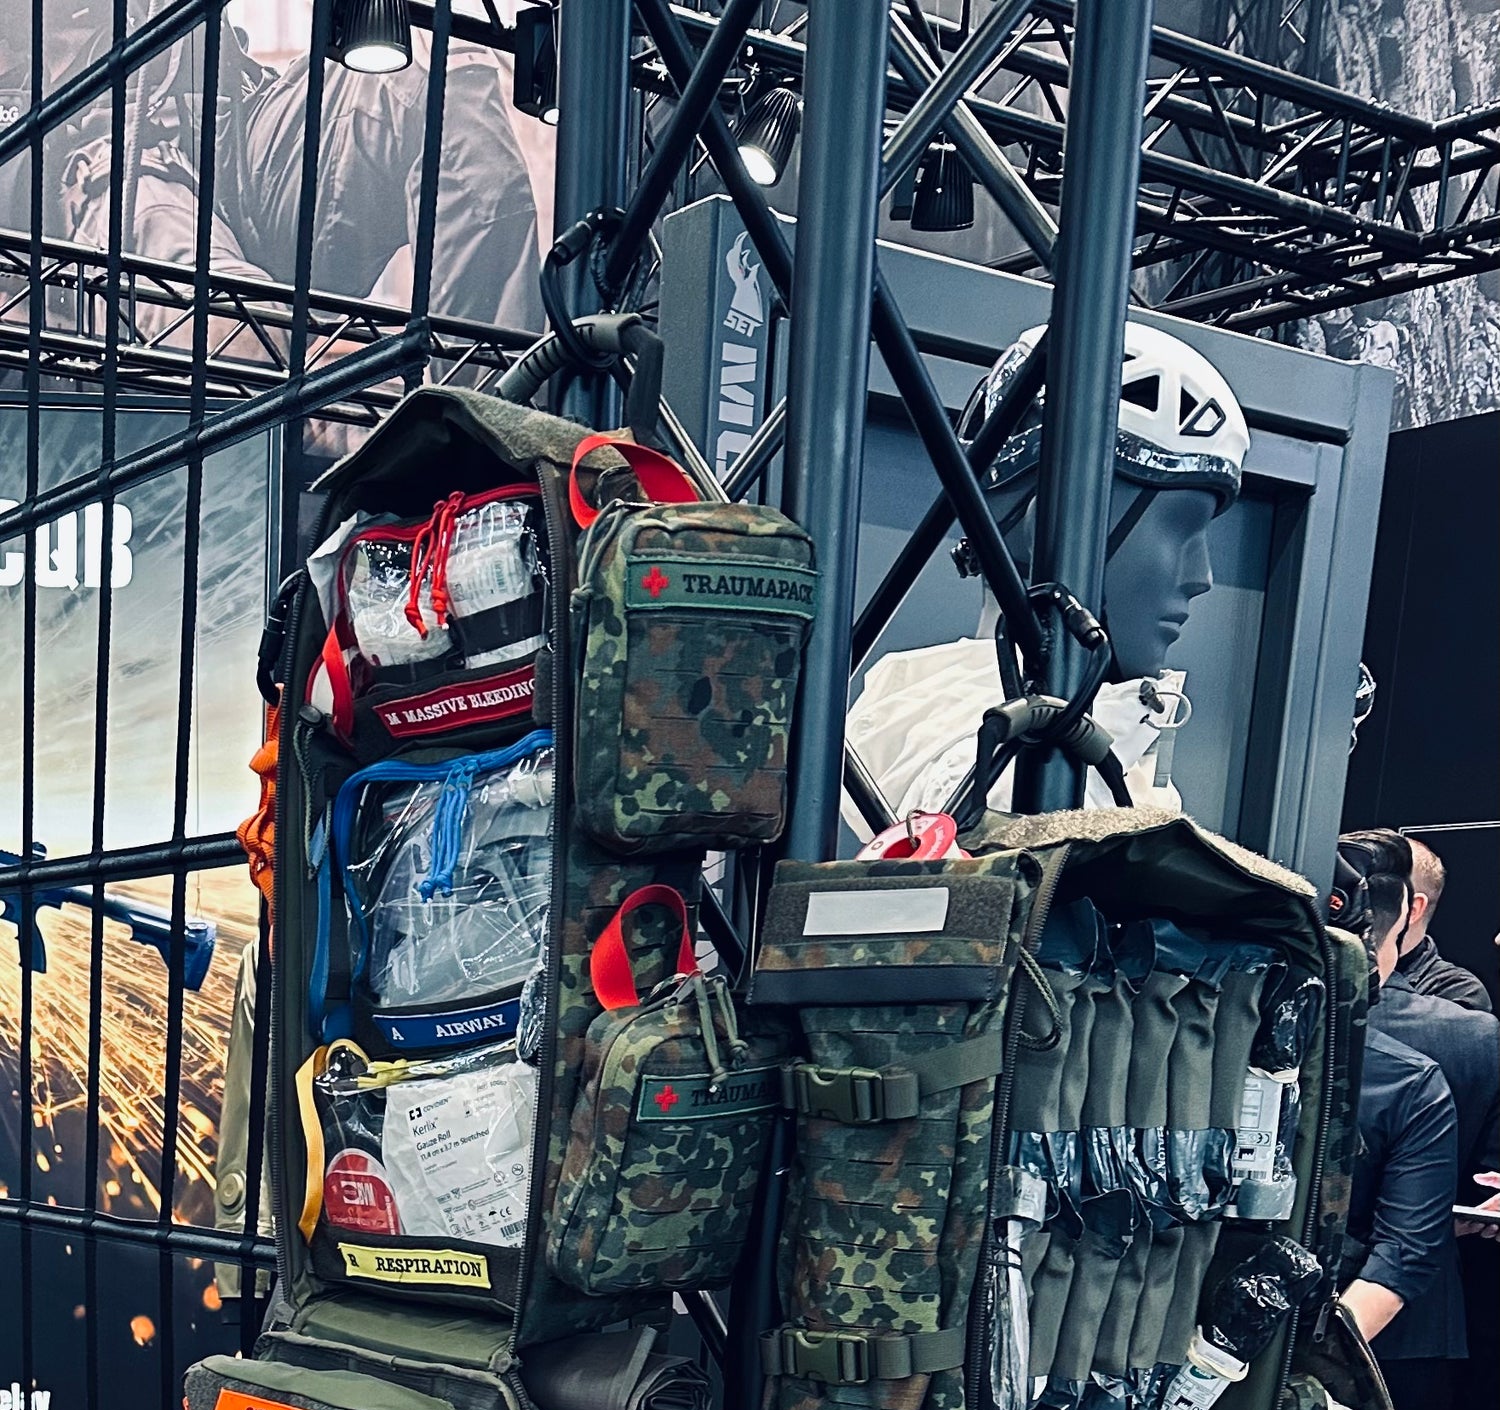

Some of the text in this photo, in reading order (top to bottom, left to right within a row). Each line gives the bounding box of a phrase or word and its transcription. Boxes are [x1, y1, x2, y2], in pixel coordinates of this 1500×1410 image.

[683, 574, 814, 605] TRAUMAPACK
[385, 713, 402, 726] M
[402, 696, 468, 723] MASSIVE
[392, 1013, 506, 1041] A AIRWAY
[412, 1119, 437, 1138] Kerlix
[347, 1253, 482, 1277] R RESPIRATION
